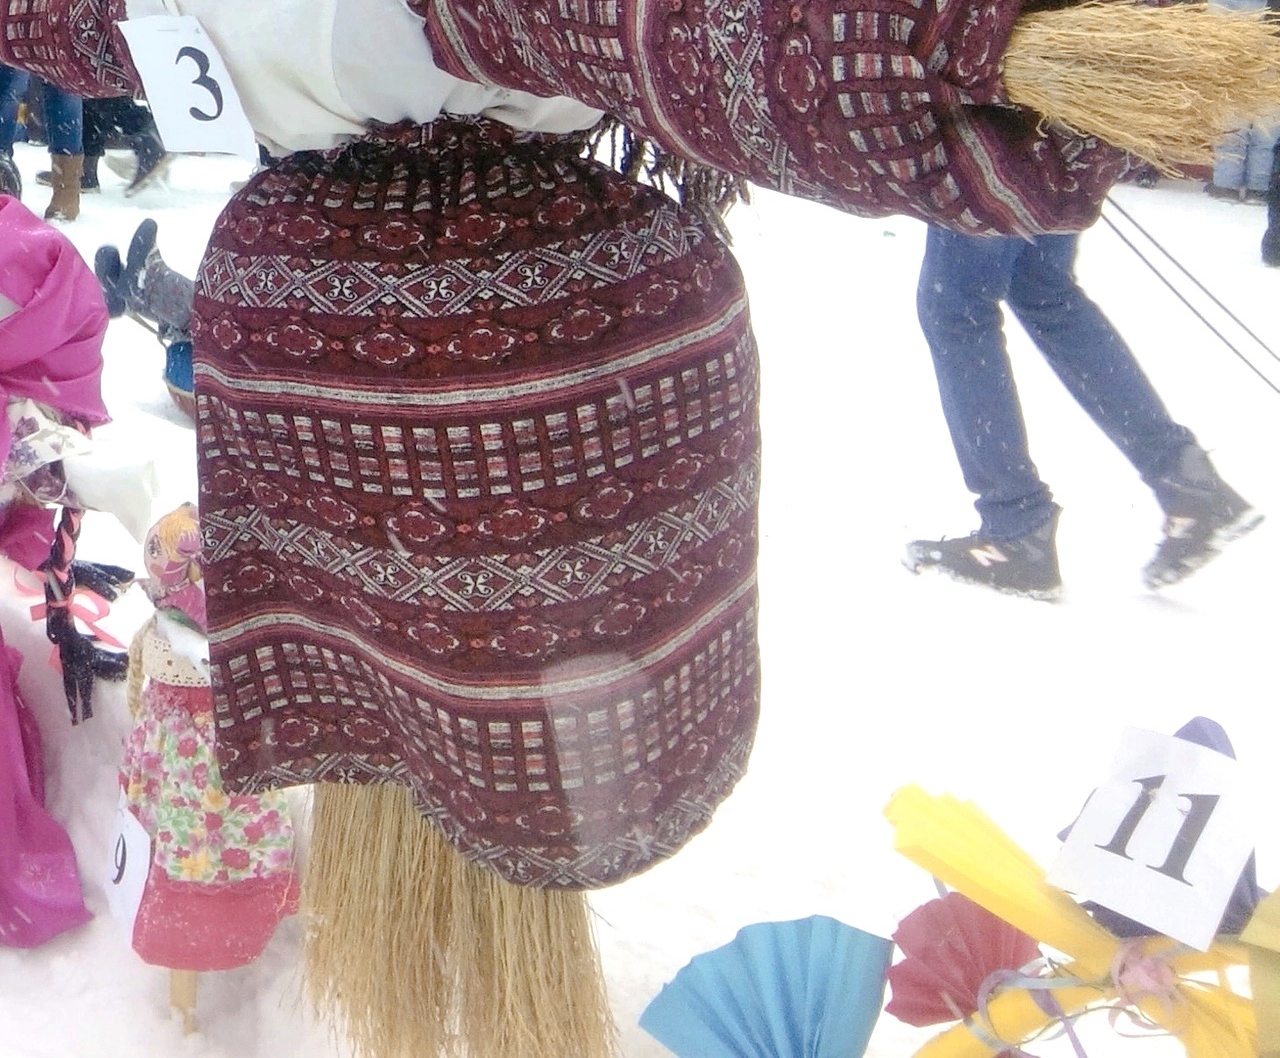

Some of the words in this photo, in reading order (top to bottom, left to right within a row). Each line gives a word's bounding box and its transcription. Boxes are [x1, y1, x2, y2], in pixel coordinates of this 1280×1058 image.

[175, 46, 223, 121] 3
[111, 833, 127, 885] 9
[1094, 774, 1221, 887] 11
